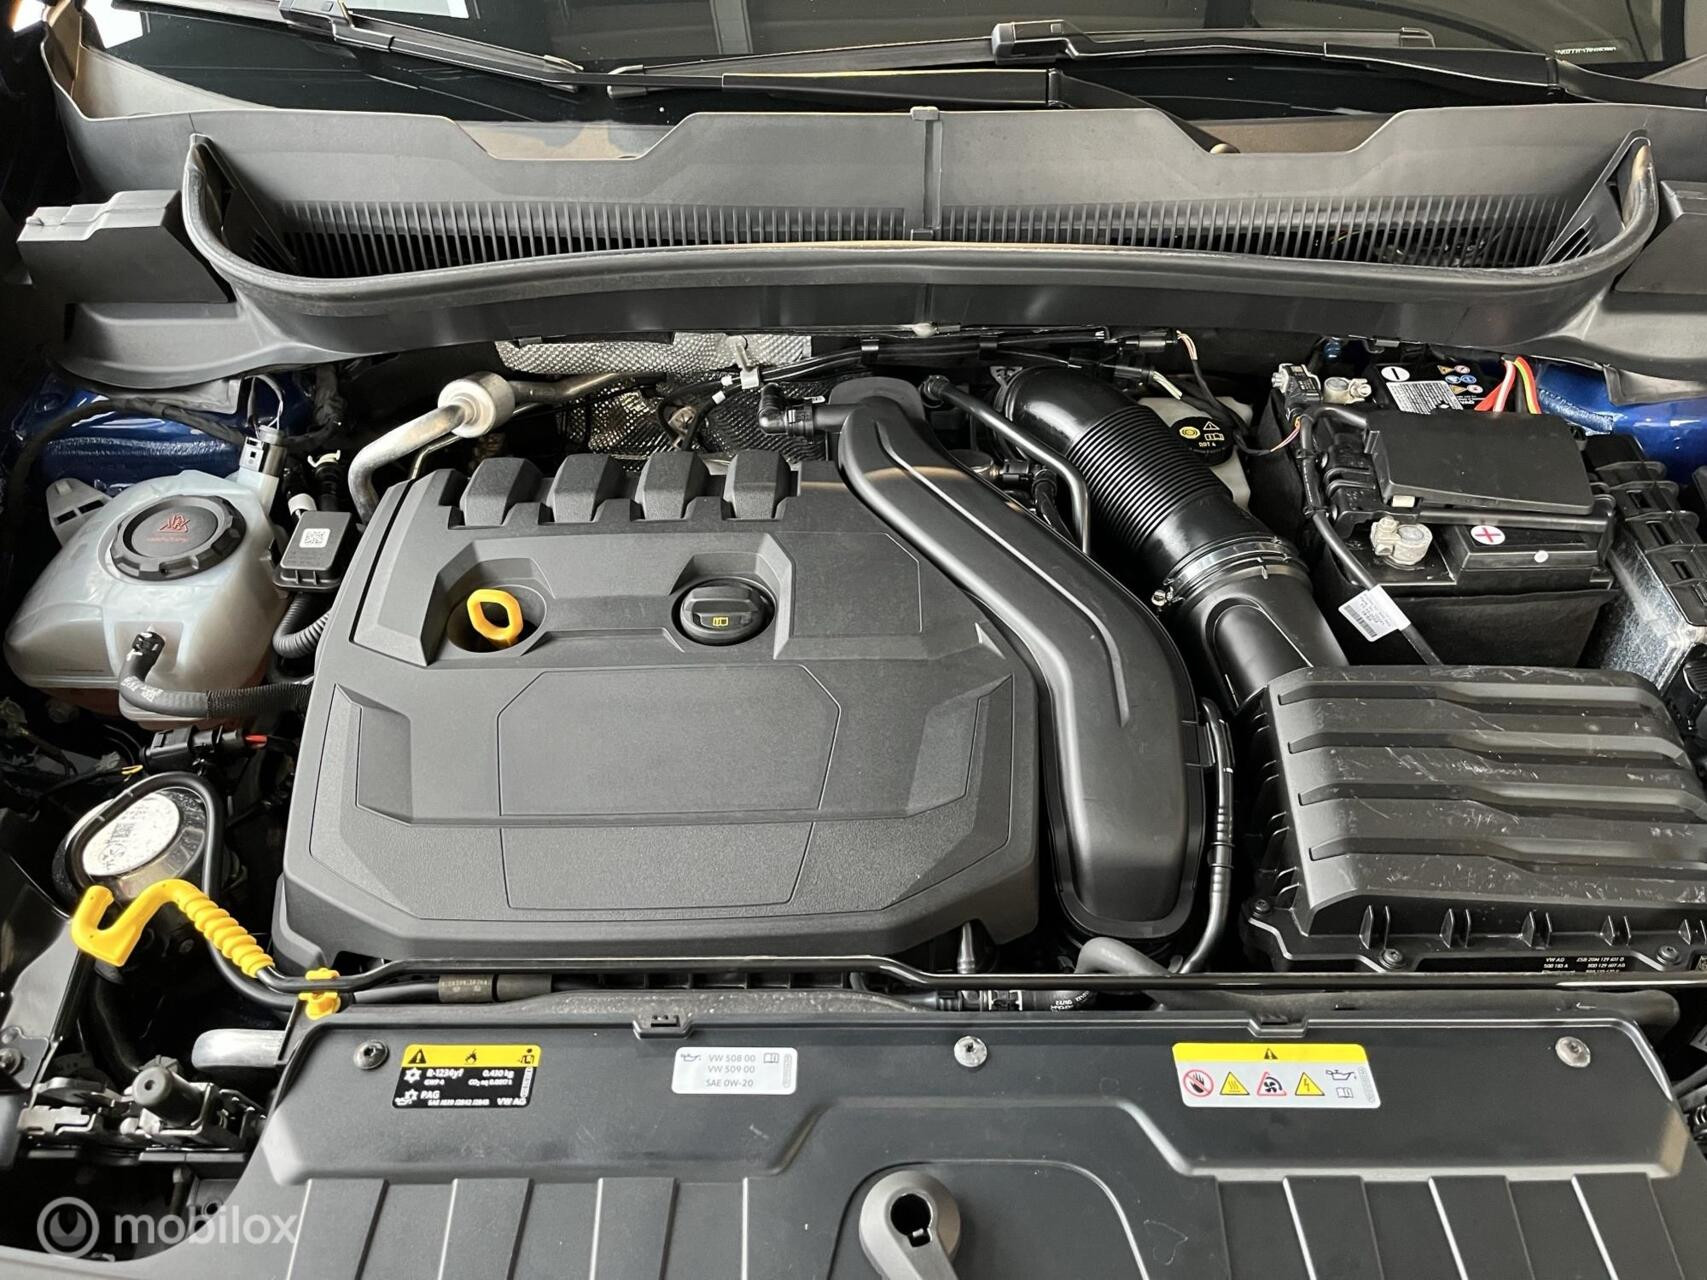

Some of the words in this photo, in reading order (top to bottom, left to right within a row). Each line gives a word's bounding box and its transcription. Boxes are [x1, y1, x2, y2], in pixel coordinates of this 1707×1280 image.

[708, 1053, 724, 1062] VW
[726, 1053, 742, 1062] 508
[744, 1053, 756, 1062] 00
[426, 1068, 464, 1079] R-1234yf
[707, 1065, 722, 1073] VW
[725, 1065, 741, 1073] 509
[743, 1065, 755, 1073] 00
[504, 1070, 515, 1079] kg
[705, 1079, 721, 1087] SAE
[723, 1079, 754, 1087] 0W-20
[420, 1090, 440, 1099] PAG
[497, 1098, 512, 1106] VW
[512, 1097, 526, 1106] AG
